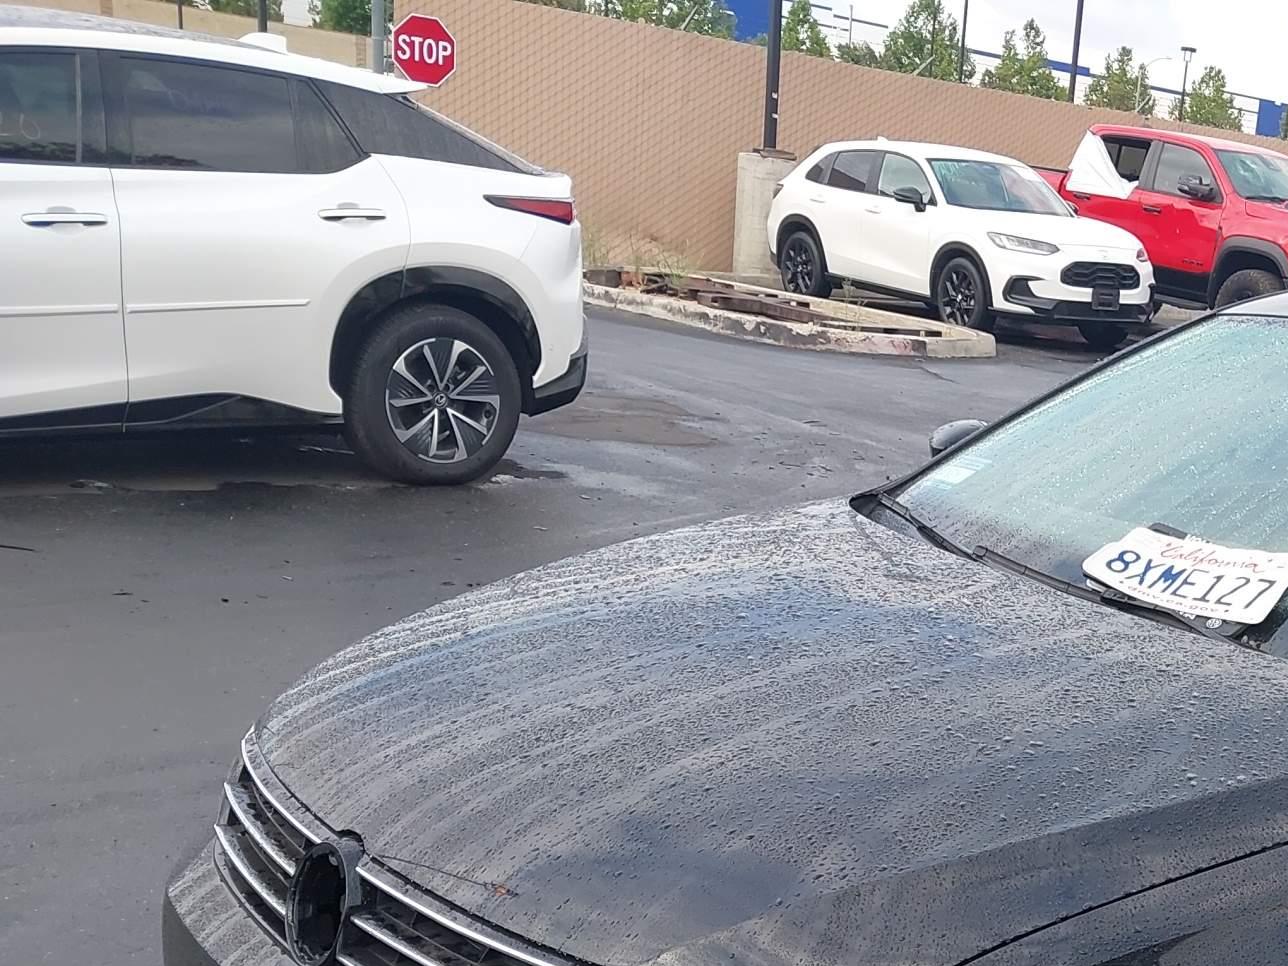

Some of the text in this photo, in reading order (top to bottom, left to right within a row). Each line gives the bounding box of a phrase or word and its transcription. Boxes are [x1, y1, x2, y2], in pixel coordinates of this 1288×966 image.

[397, 34, 452, 65] STOP
[1161, 543, 1265, 573] California
[1106, 550, 1277, 610] 8XME127
